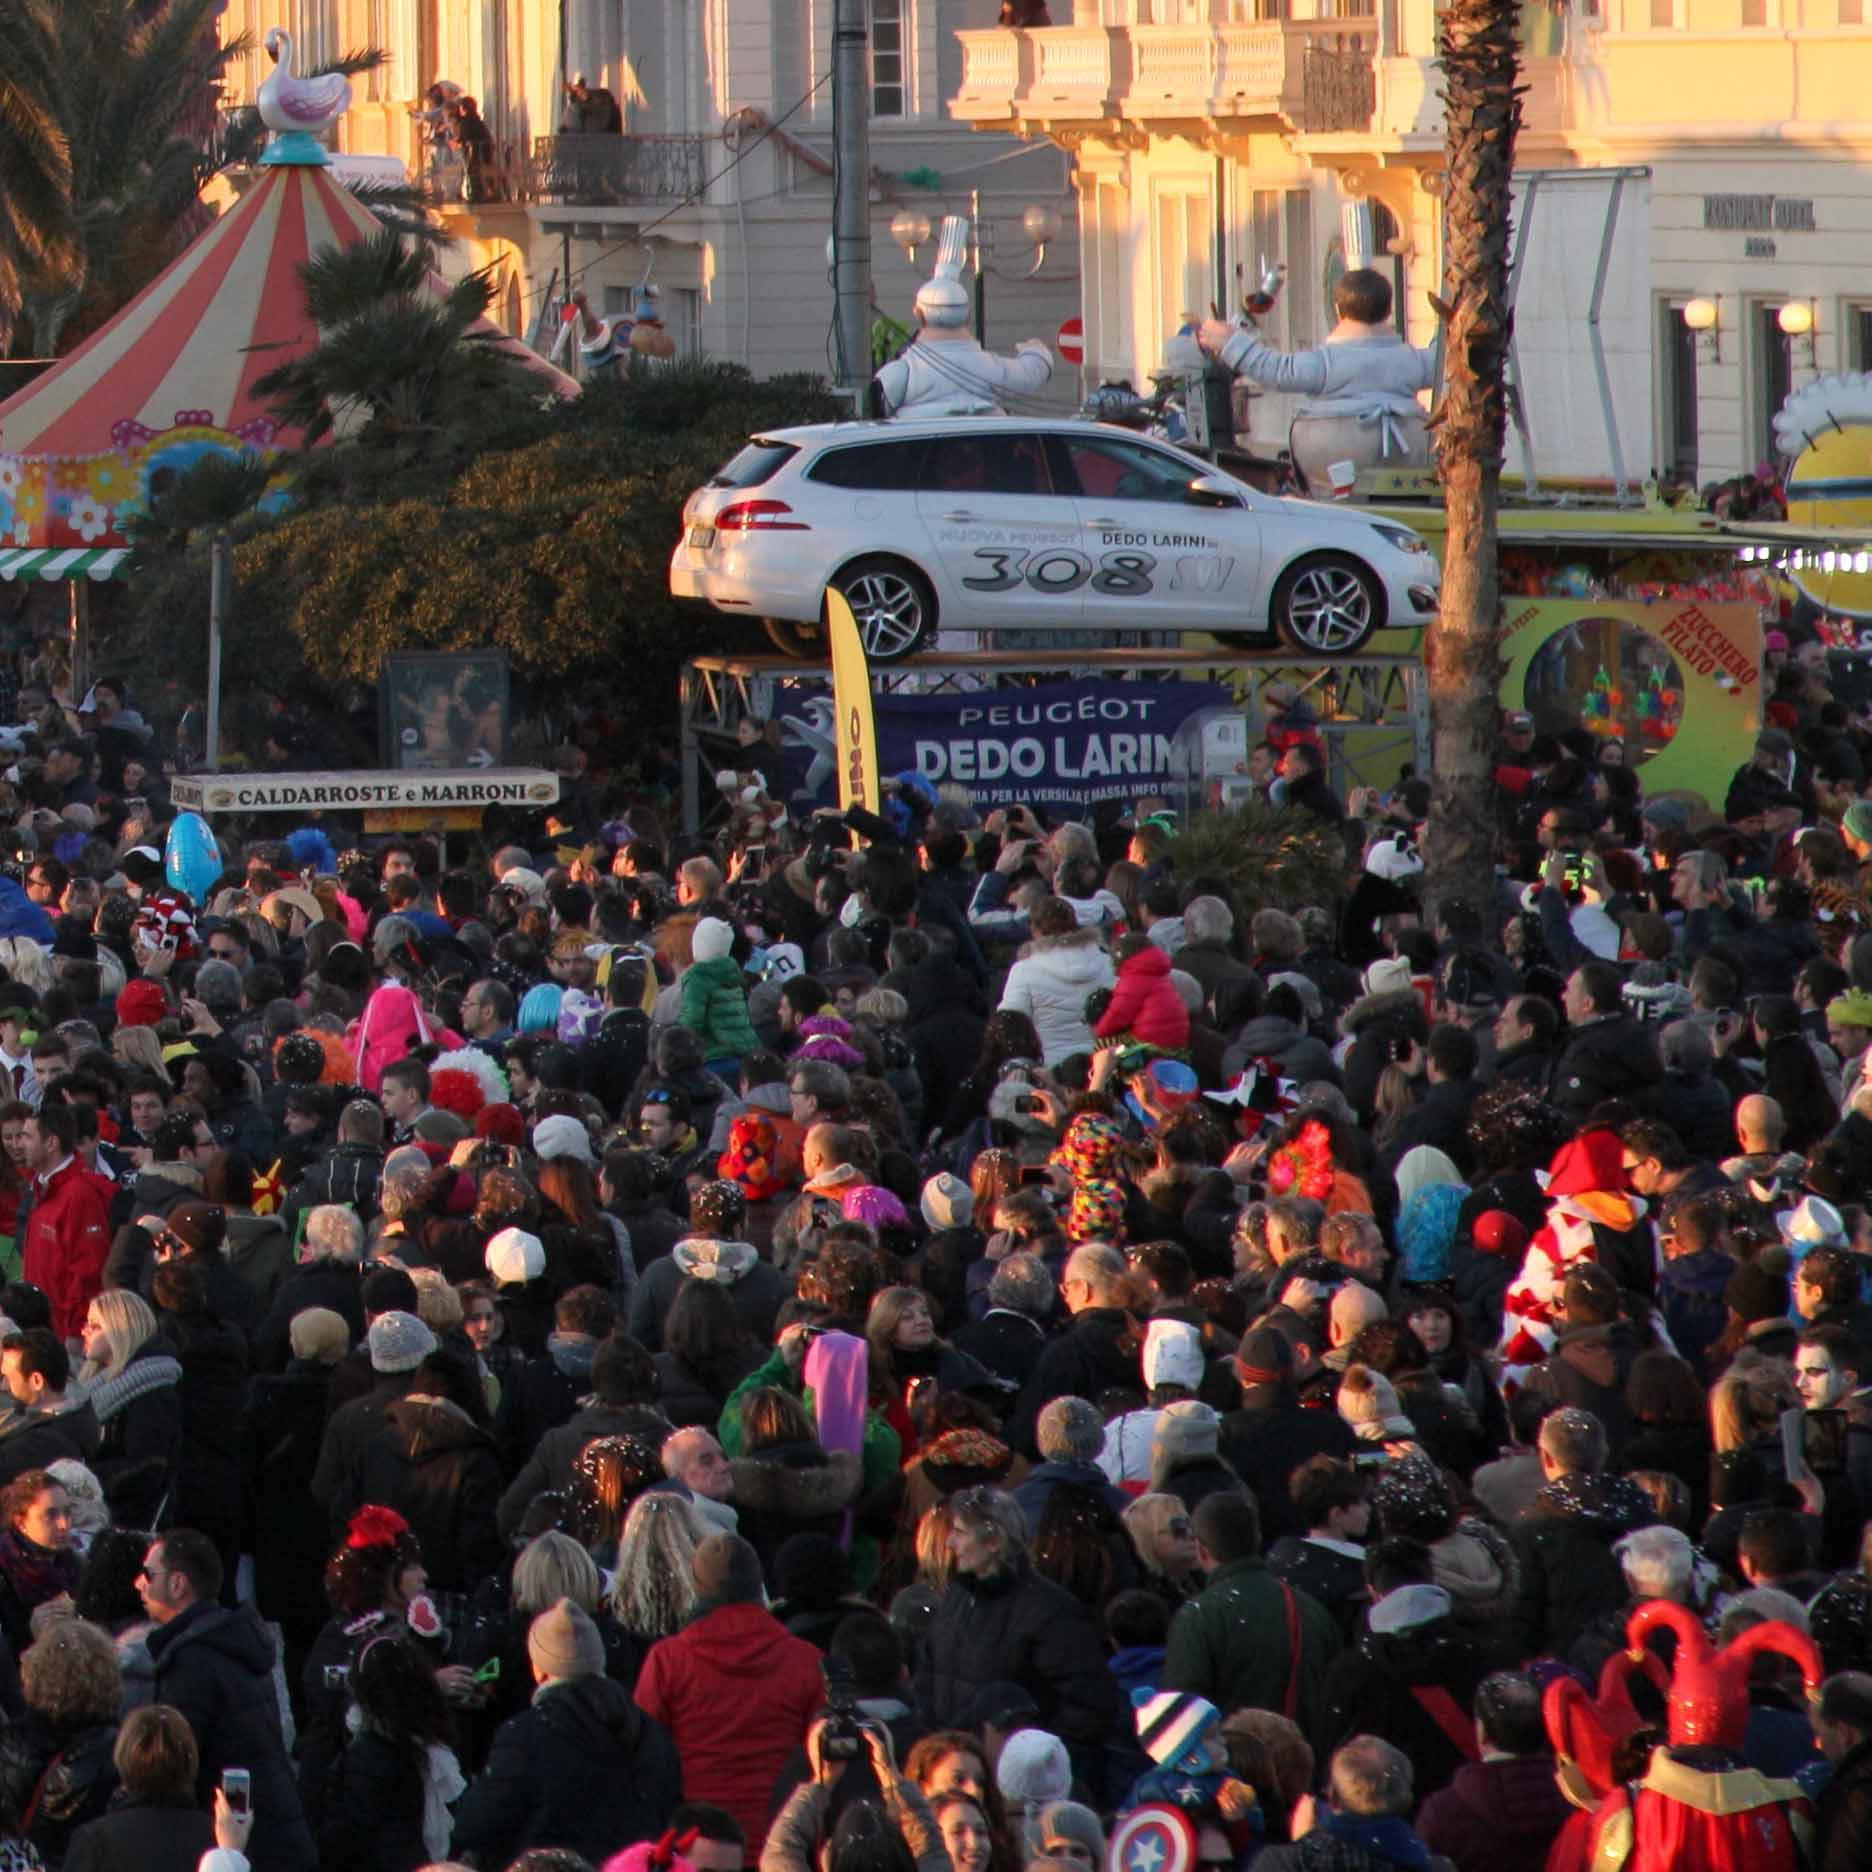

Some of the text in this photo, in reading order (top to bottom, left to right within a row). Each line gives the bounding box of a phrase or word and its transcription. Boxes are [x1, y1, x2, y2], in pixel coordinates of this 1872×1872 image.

[1101, 532, 1148, 548] DEDO
[1152, 533, 1206, 549] LARINI
[961, 547, 1157, 597] 308
[1660, 619, 1717, 676] FILATO
[1678, 604, 1759, 686] ZUCCHERO
[915, 736, 1046, 781] DEDO
[237, 783, 527, 807] CALDARROSTE e MARRONI
[991, 789, 1012, 803] PER
[1015, 789, 1031, 802] LA
[1032, 787, 1083, 803] VERSILIA
[1091, 785, 1129, 802] MASSA
